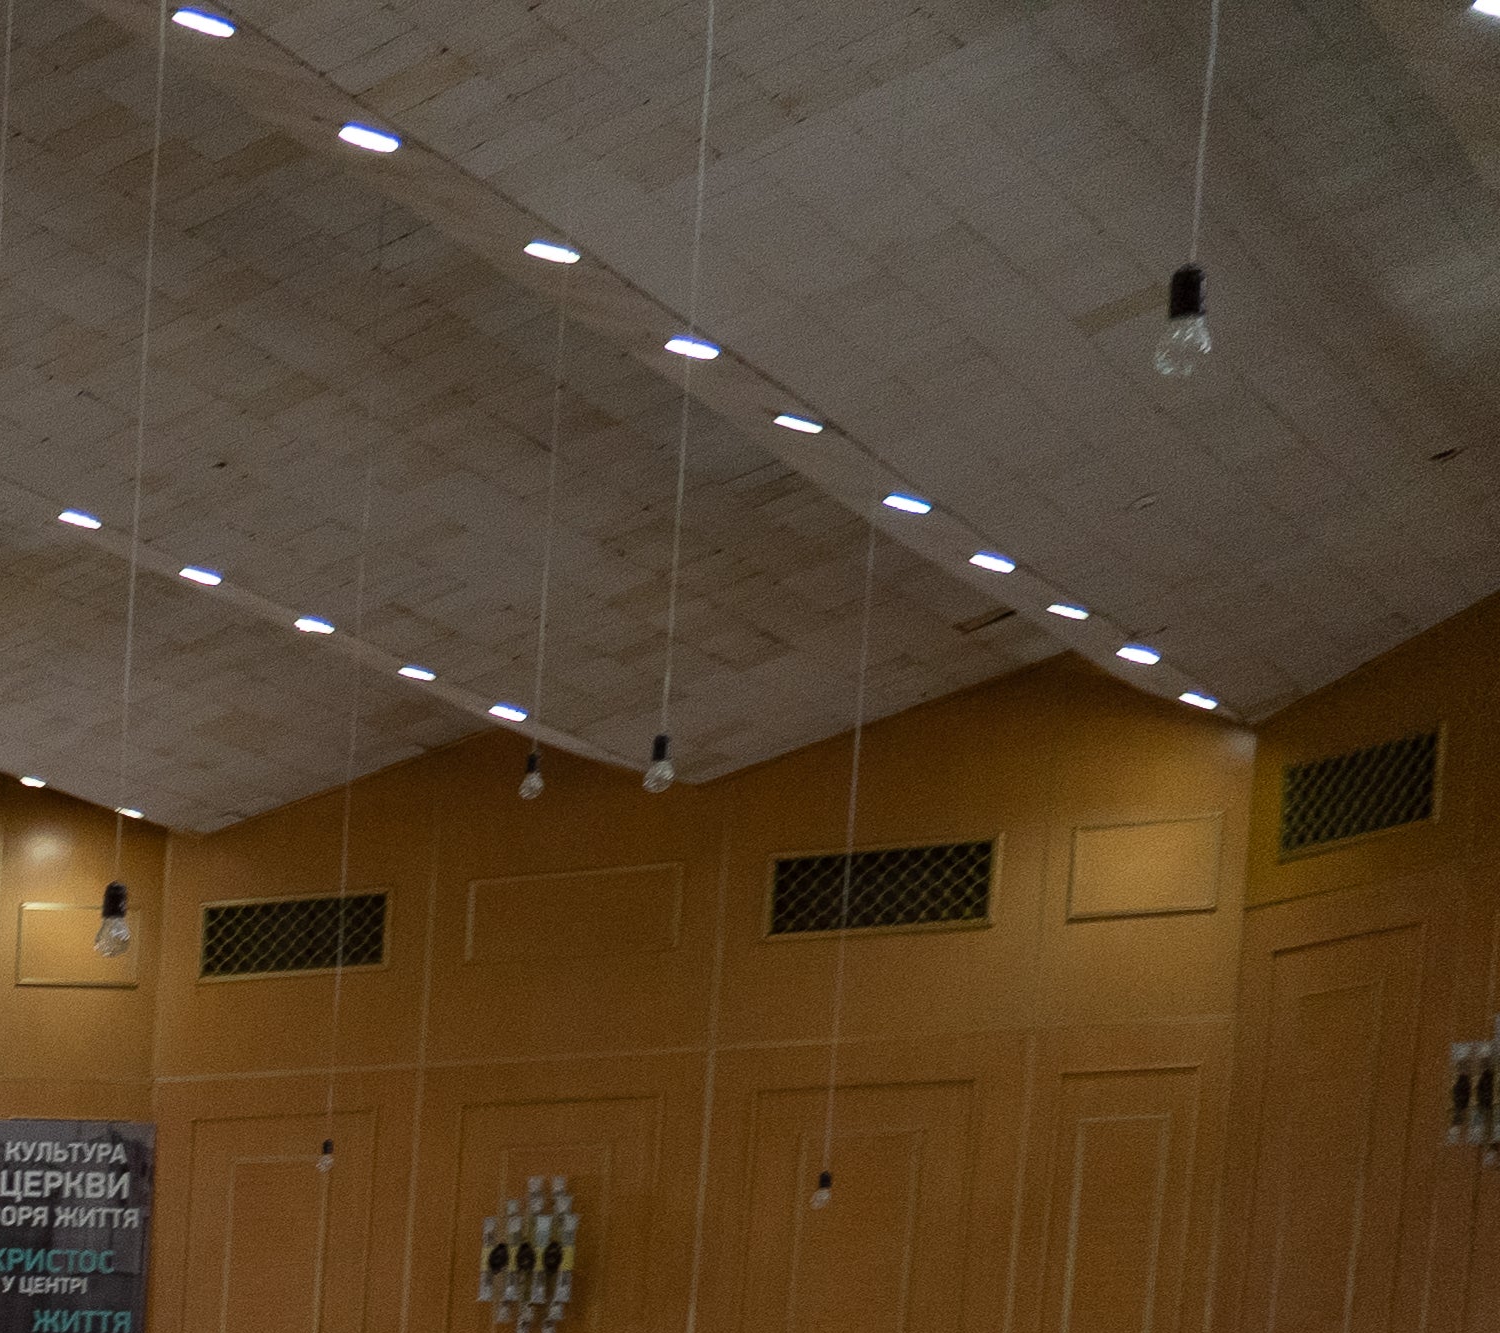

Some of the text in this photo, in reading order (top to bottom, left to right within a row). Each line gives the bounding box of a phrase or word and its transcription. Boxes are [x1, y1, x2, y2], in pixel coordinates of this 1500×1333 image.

[4, 1141, 128, 1165] КУЛЬТУРА
[53, 1206, 140, 1229] ЖИТТЯ
[1, 1275, 88, 1296] У ЦЕНТРІ
[31, 1309, 132, 1333] ЖИТТЯ
